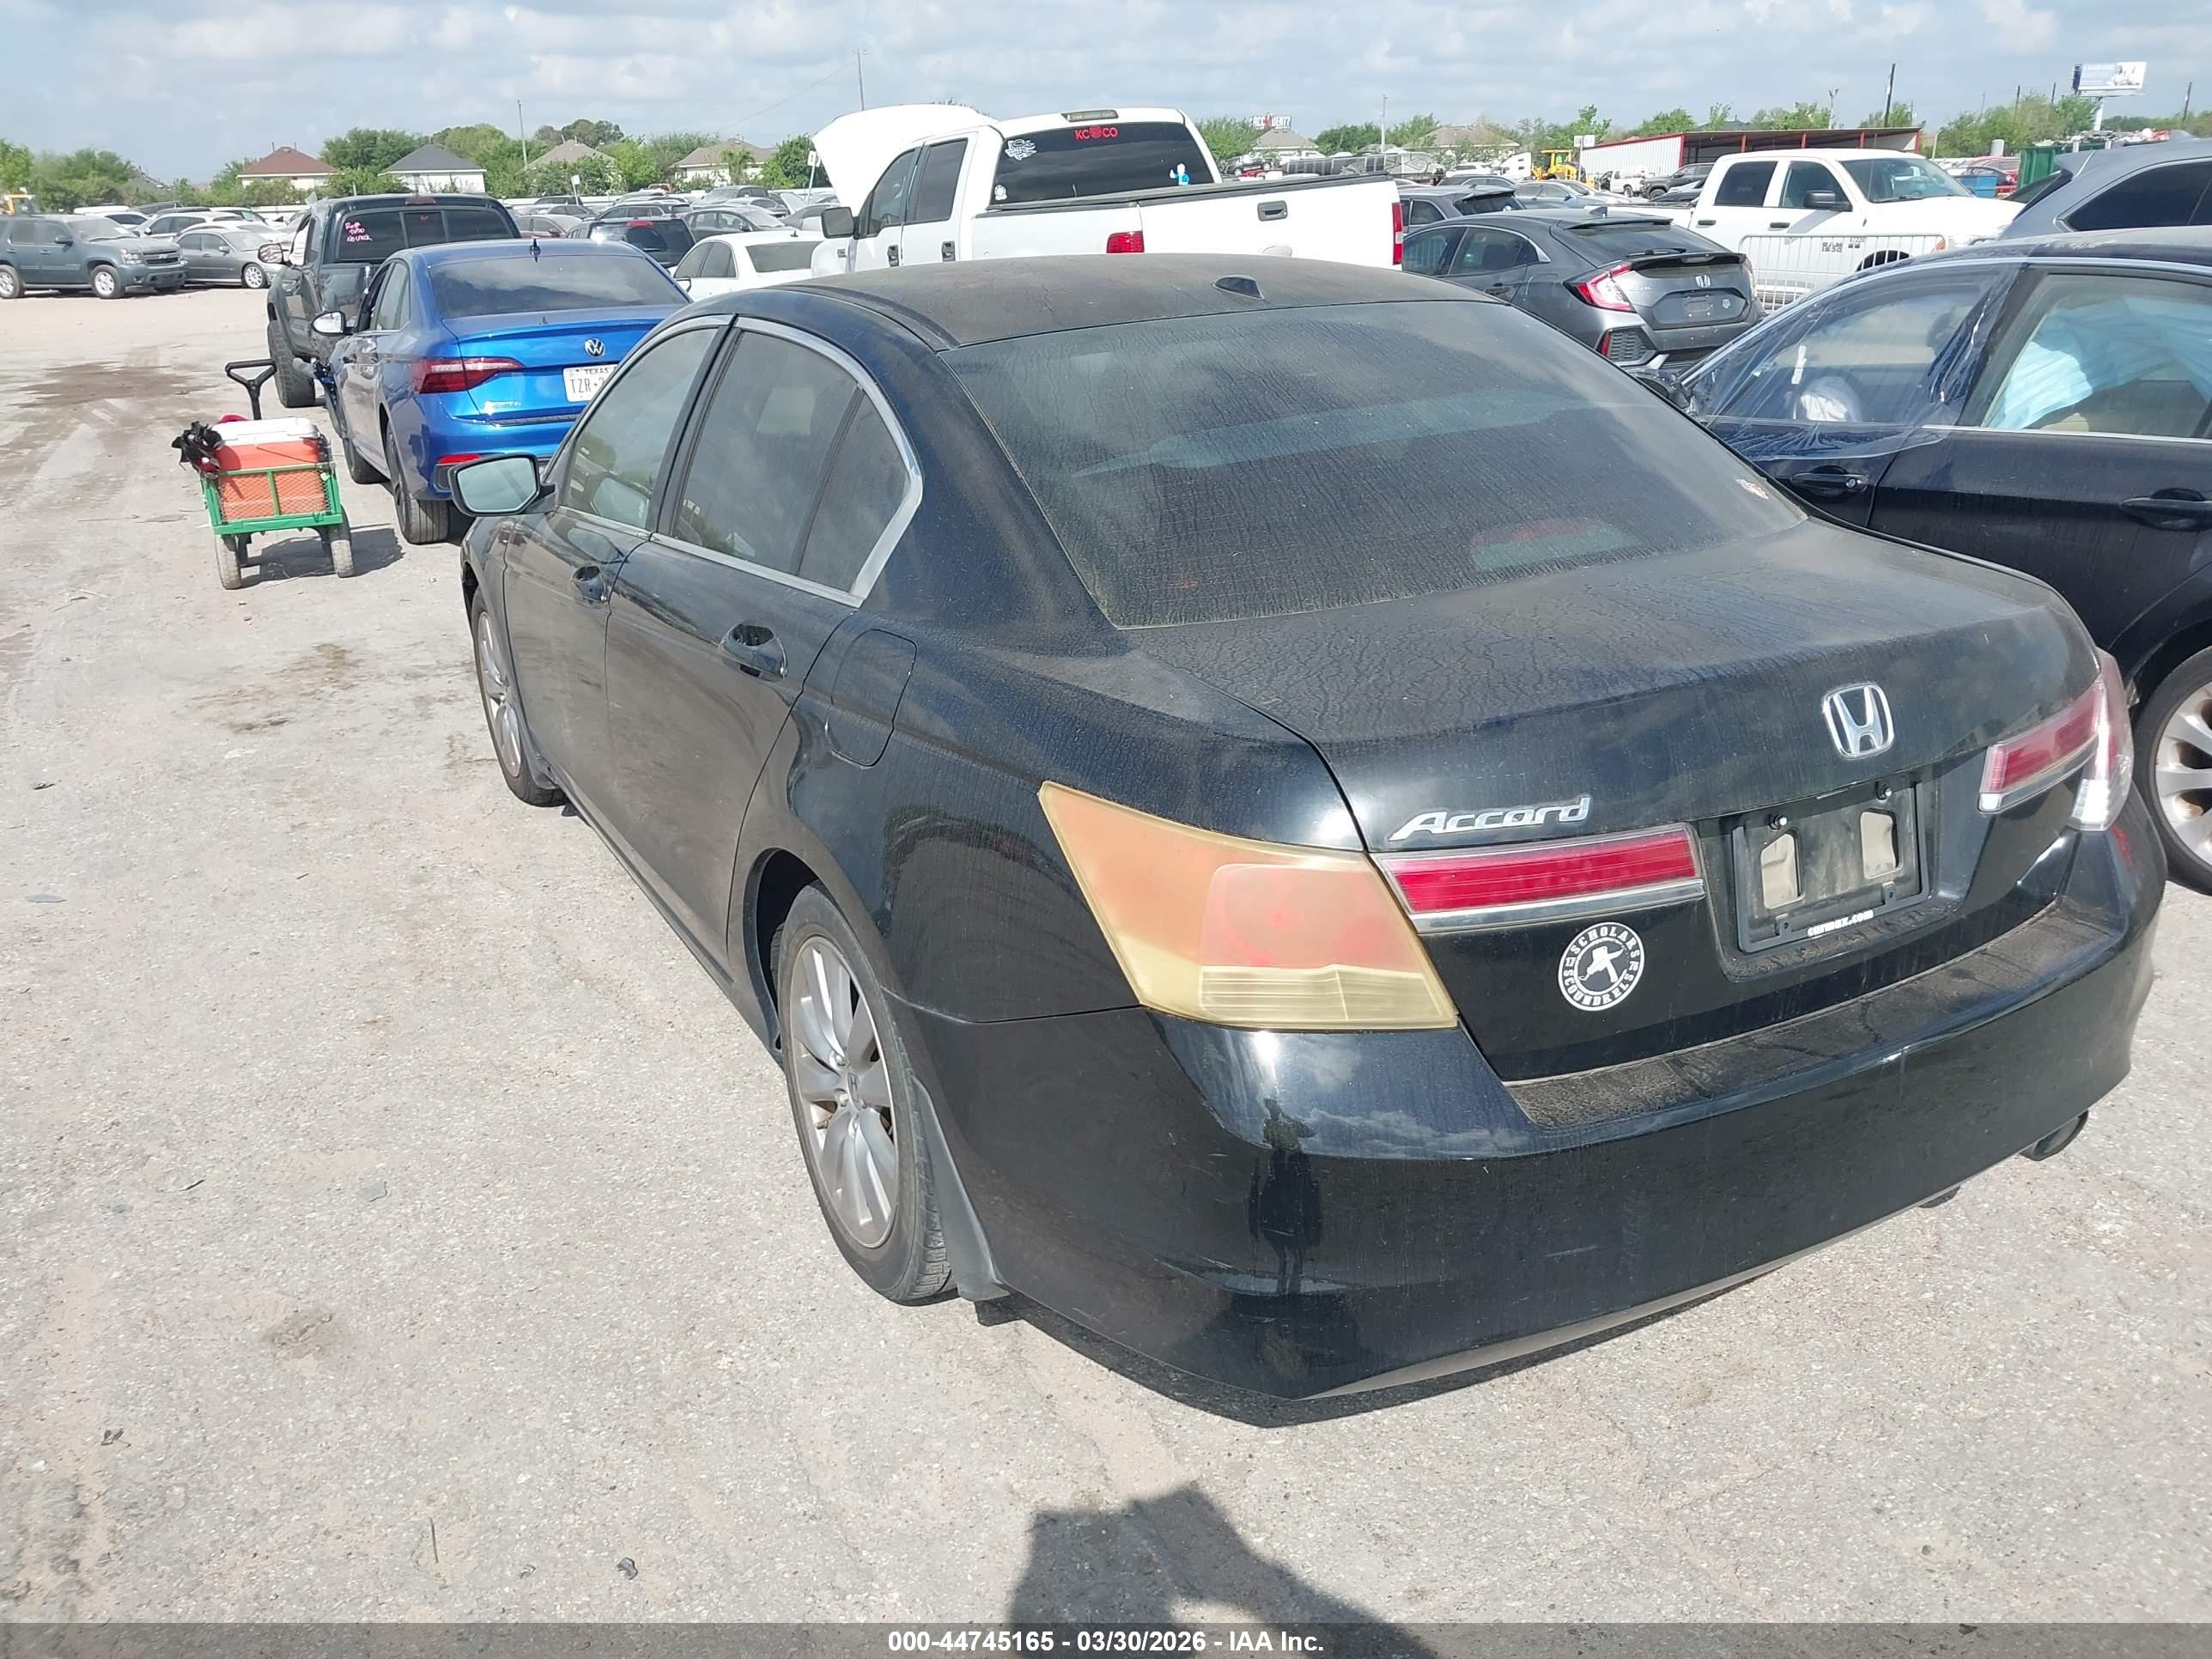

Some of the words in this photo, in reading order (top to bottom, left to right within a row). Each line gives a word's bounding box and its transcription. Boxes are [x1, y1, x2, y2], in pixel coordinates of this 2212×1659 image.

[1389, 797, 1592, 842] Accord
[1570, 926, 1640, 958] SCHOLARS
[1563, 969, 1635, 1006] SCOUNDRELS
